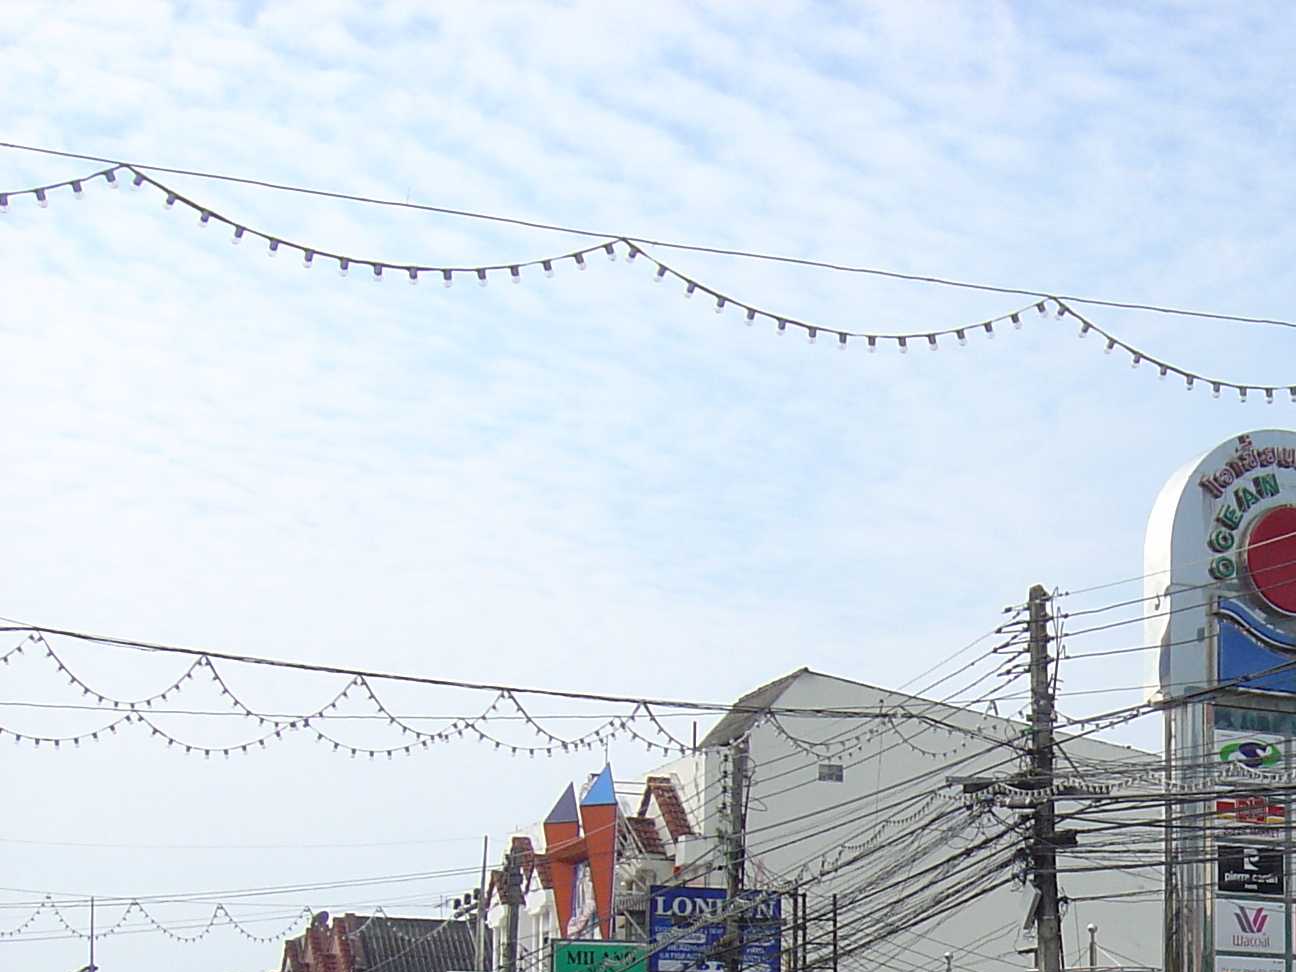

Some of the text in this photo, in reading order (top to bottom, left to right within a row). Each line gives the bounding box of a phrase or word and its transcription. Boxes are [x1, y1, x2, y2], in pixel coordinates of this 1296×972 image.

[1208, 472, 1281, 580] OCEAN
[1225, 871, 1250, 884] pierre
[655, 896, 776, 919] LONN
[1232, 934, 1270, 948] Wacoal
